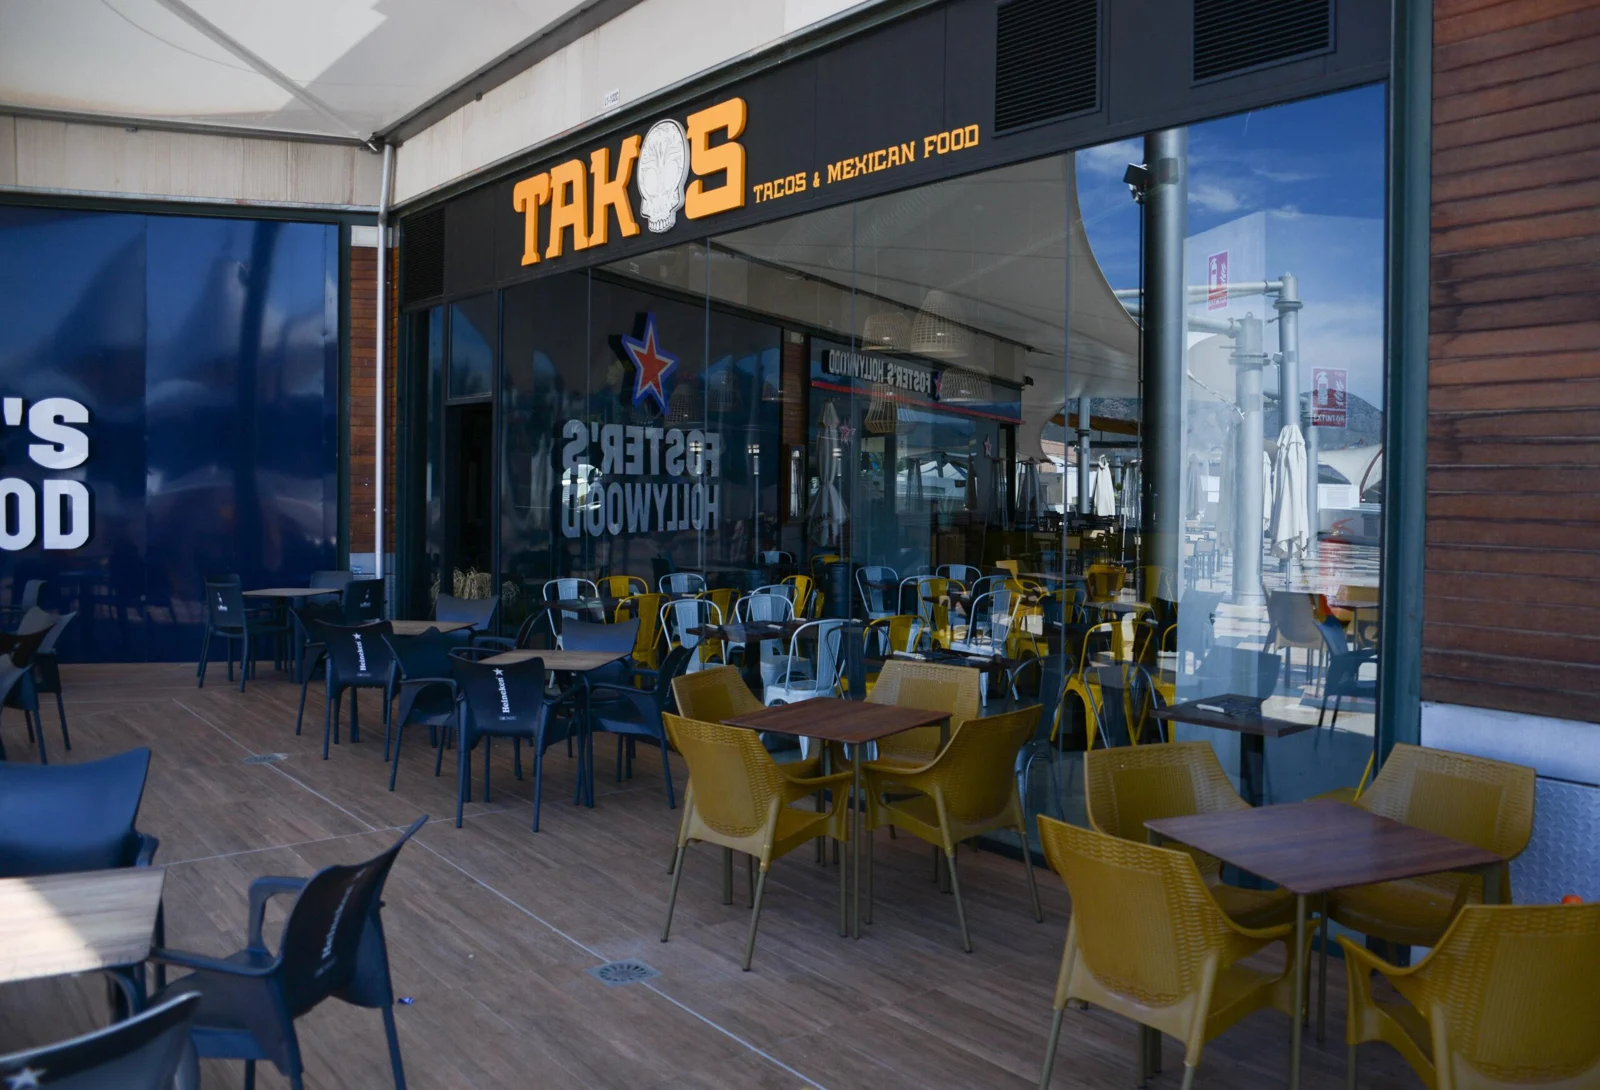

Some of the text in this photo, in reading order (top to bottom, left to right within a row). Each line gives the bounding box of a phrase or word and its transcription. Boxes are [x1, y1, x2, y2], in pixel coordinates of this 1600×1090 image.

[753, 124, 979, 204] TACOS & MEXICAN FOOD
[355, 641, 367, 671] Heineken
[498, 677, 511, 713] Heineken
